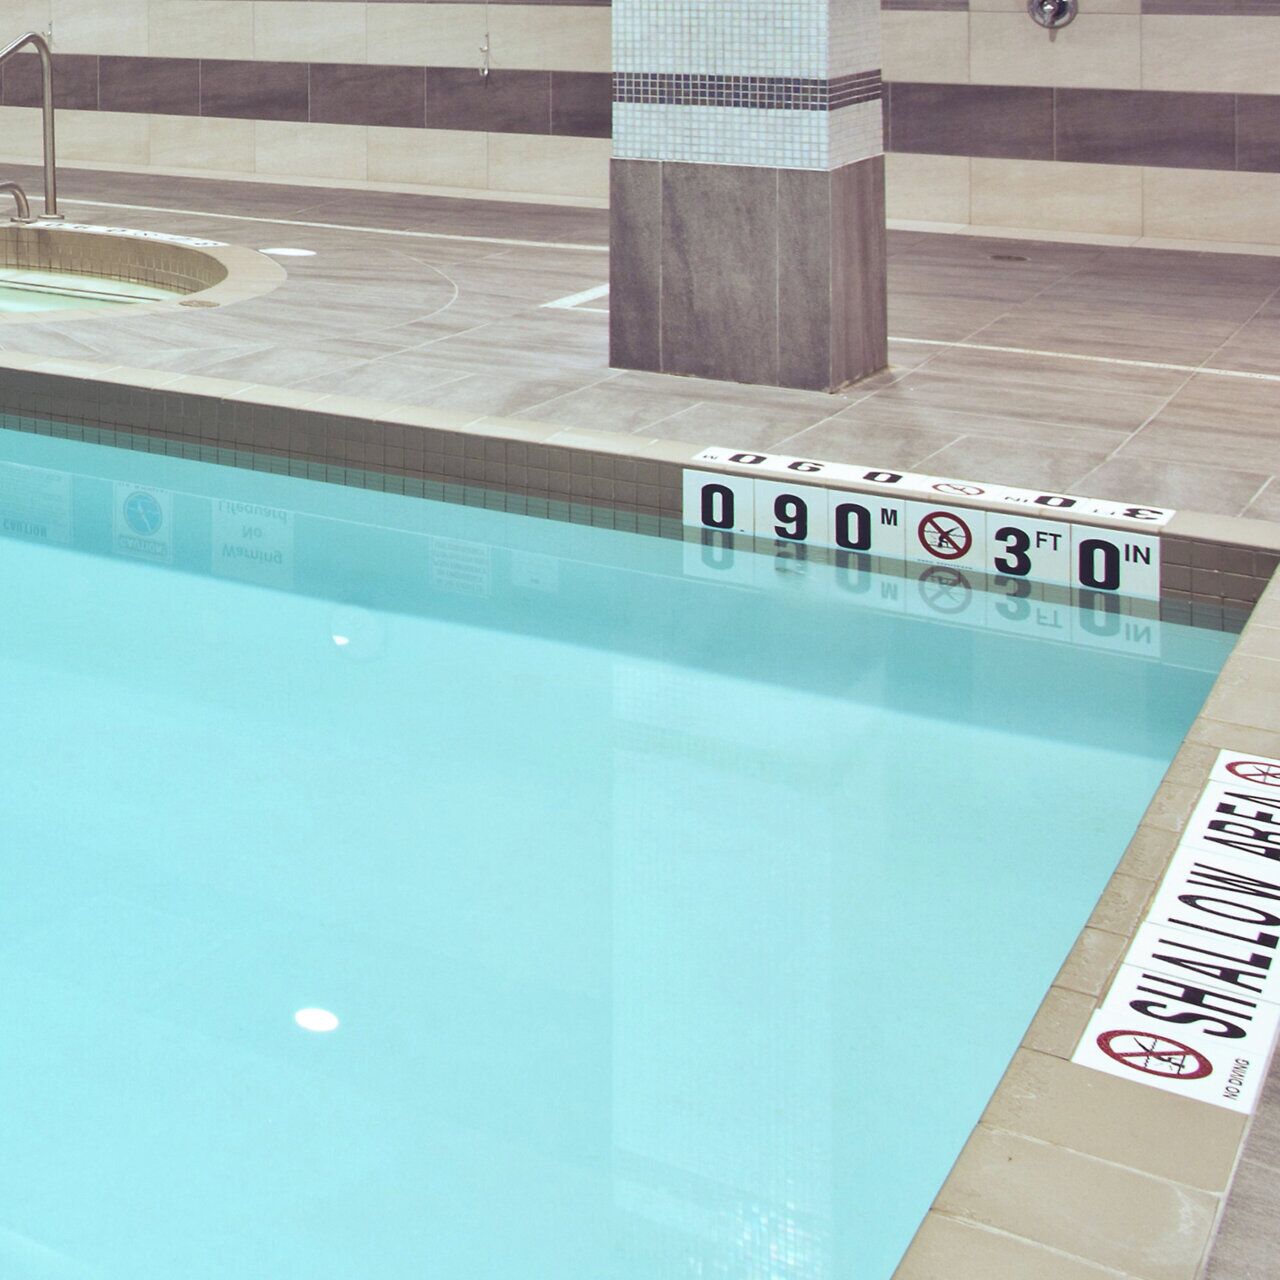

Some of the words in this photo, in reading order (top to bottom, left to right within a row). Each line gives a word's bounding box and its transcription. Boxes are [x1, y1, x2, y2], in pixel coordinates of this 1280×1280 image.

[1129, 862, 1280, 1039] SHALLOW
[1228, 1057, 1250, 1087] DIVING
[1223, 1085, 1240, 1101] NO
